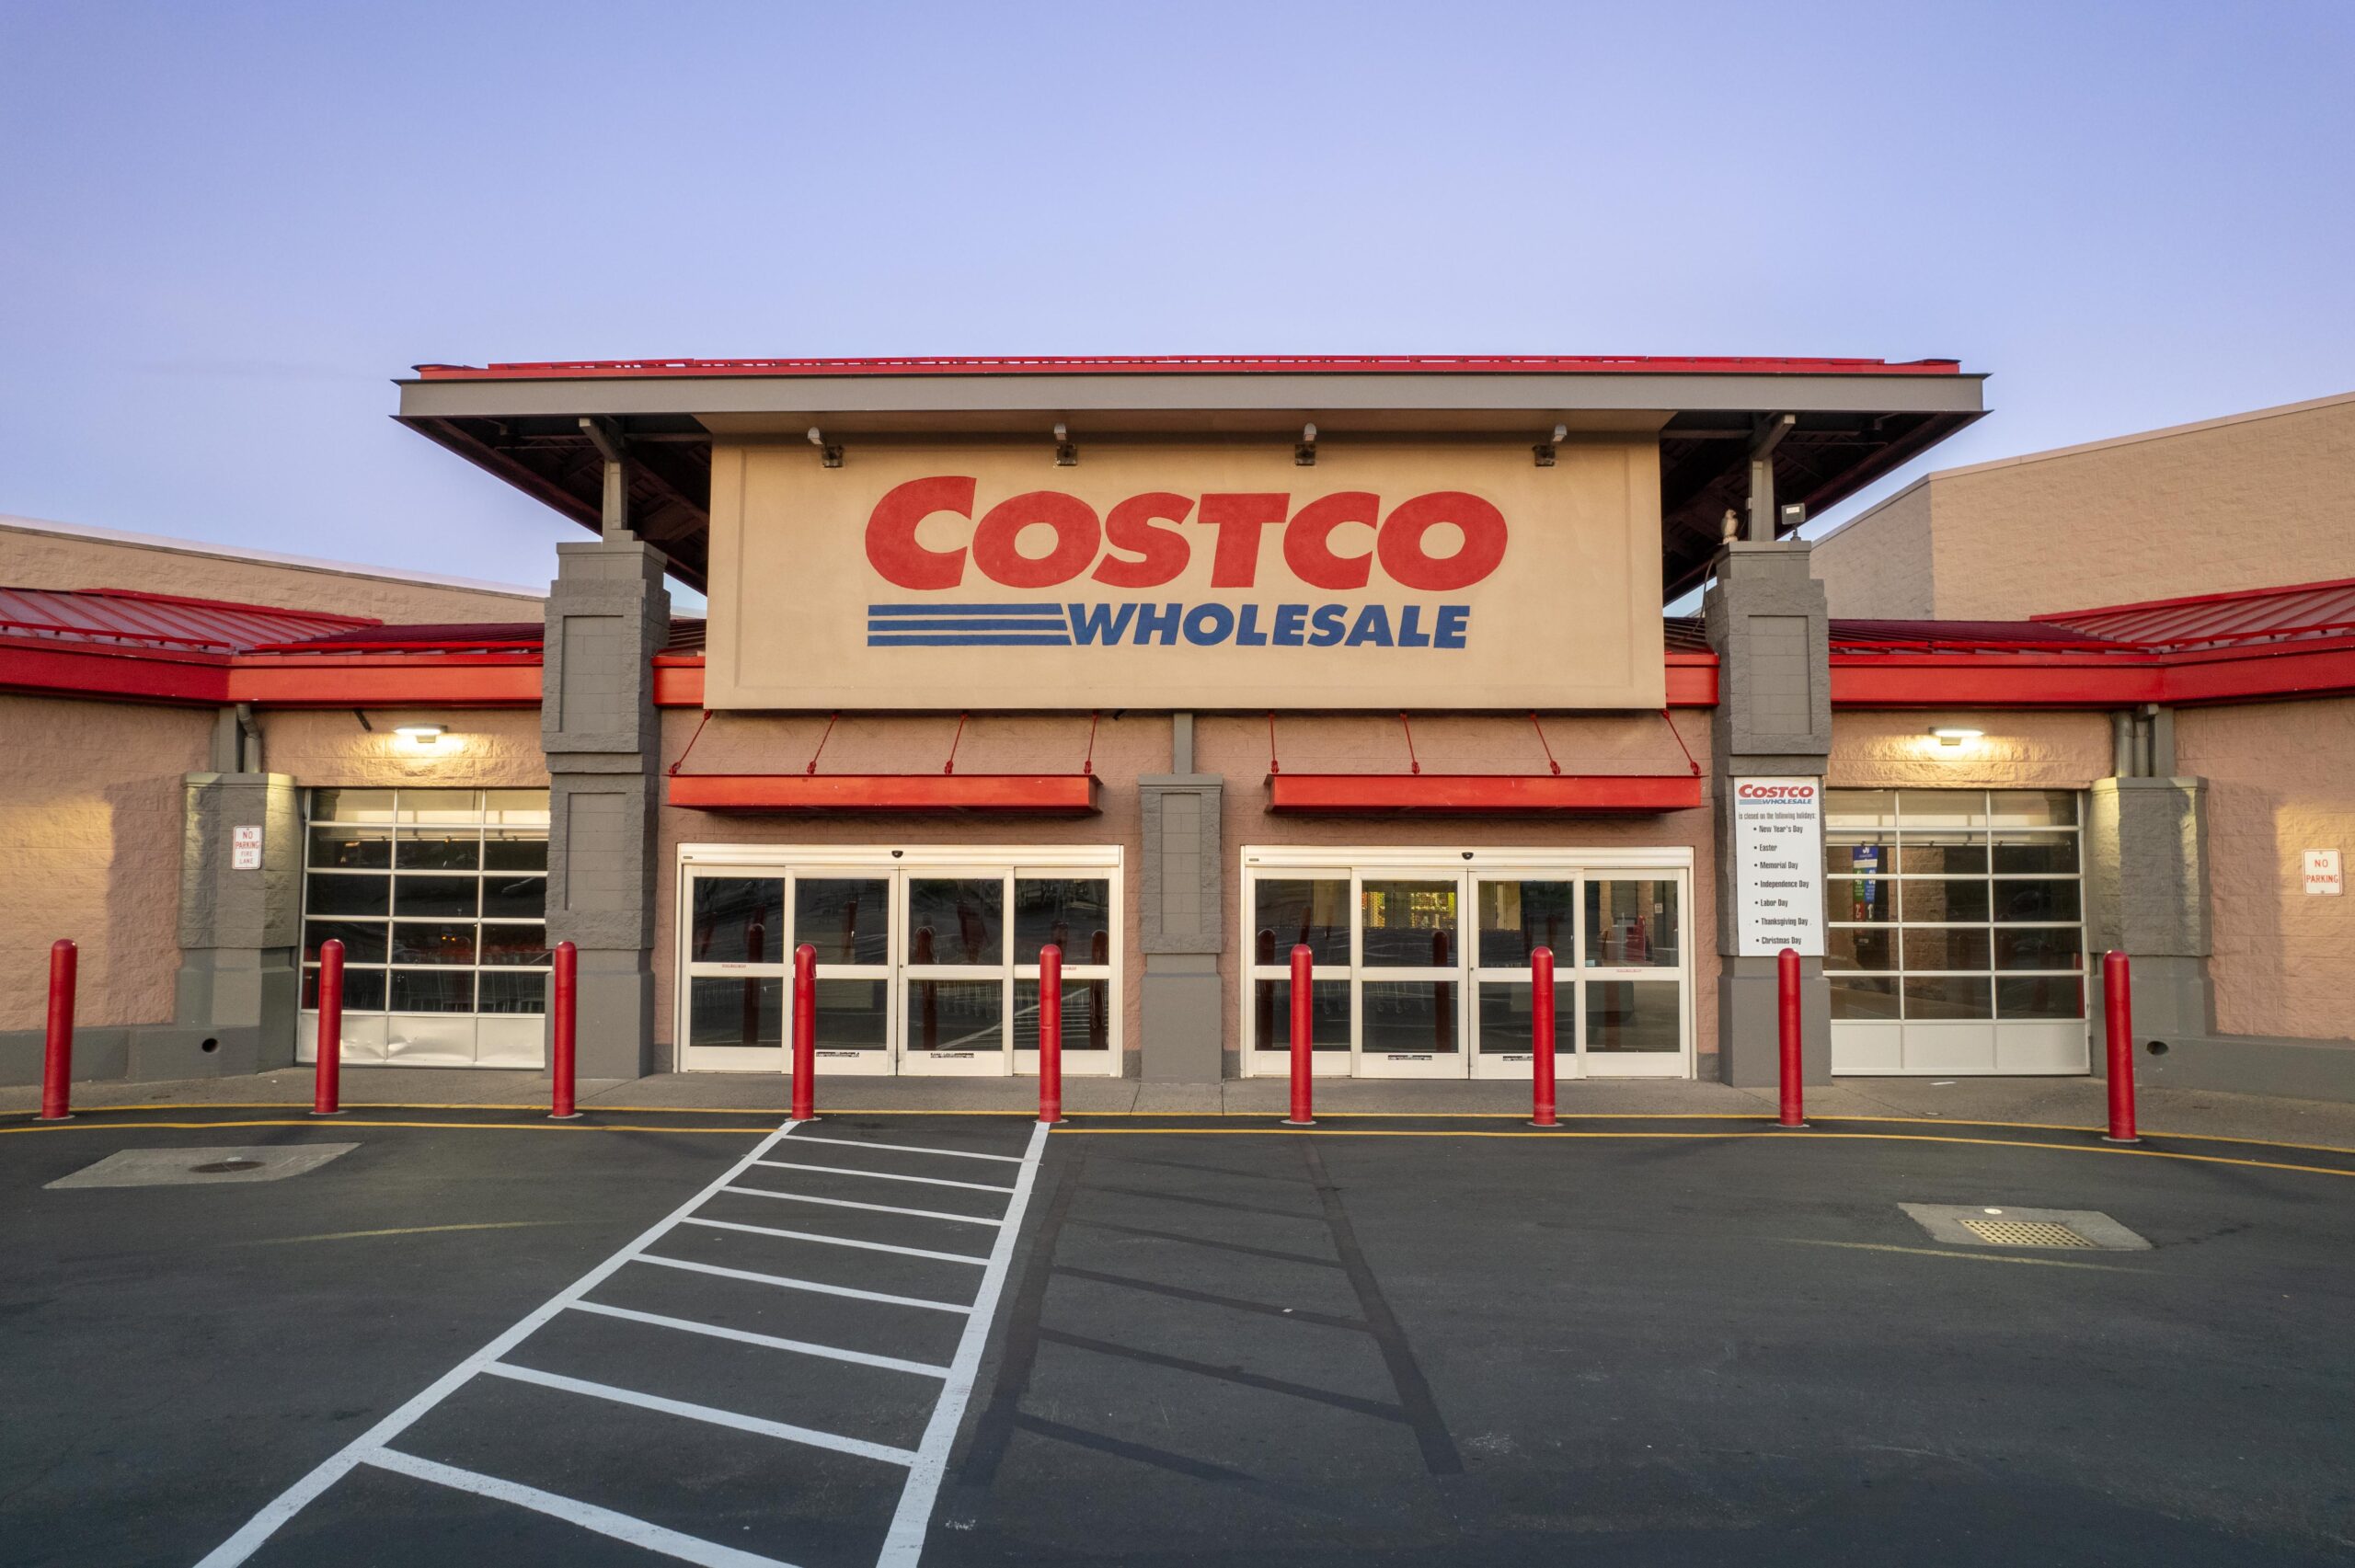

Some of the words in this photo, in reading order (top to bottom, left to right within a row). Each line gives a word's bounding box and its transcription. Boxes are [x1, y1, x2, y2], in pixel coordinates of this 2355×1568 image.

[865, 475, 1508, 591] COSTCO
[1067, 603, 1470, 649] WHOLESALE
[1739, 784, 1814, 798] COSTCO
[1775, 812, 1796, 820] following
[1788, 862, 1798, 870] Day
[2315, 859, 2328, 867] NO
[2306, 875, 2338, 883] PARKING
[1760, 880, 1798, 888] Independence
[1799, 880, 1809, 888] Day
[1778, 899, 1788, 908] Day
[1761, 918, 1797, 926] Thanksgiving
[1798, 918, 1808, 926] Day
